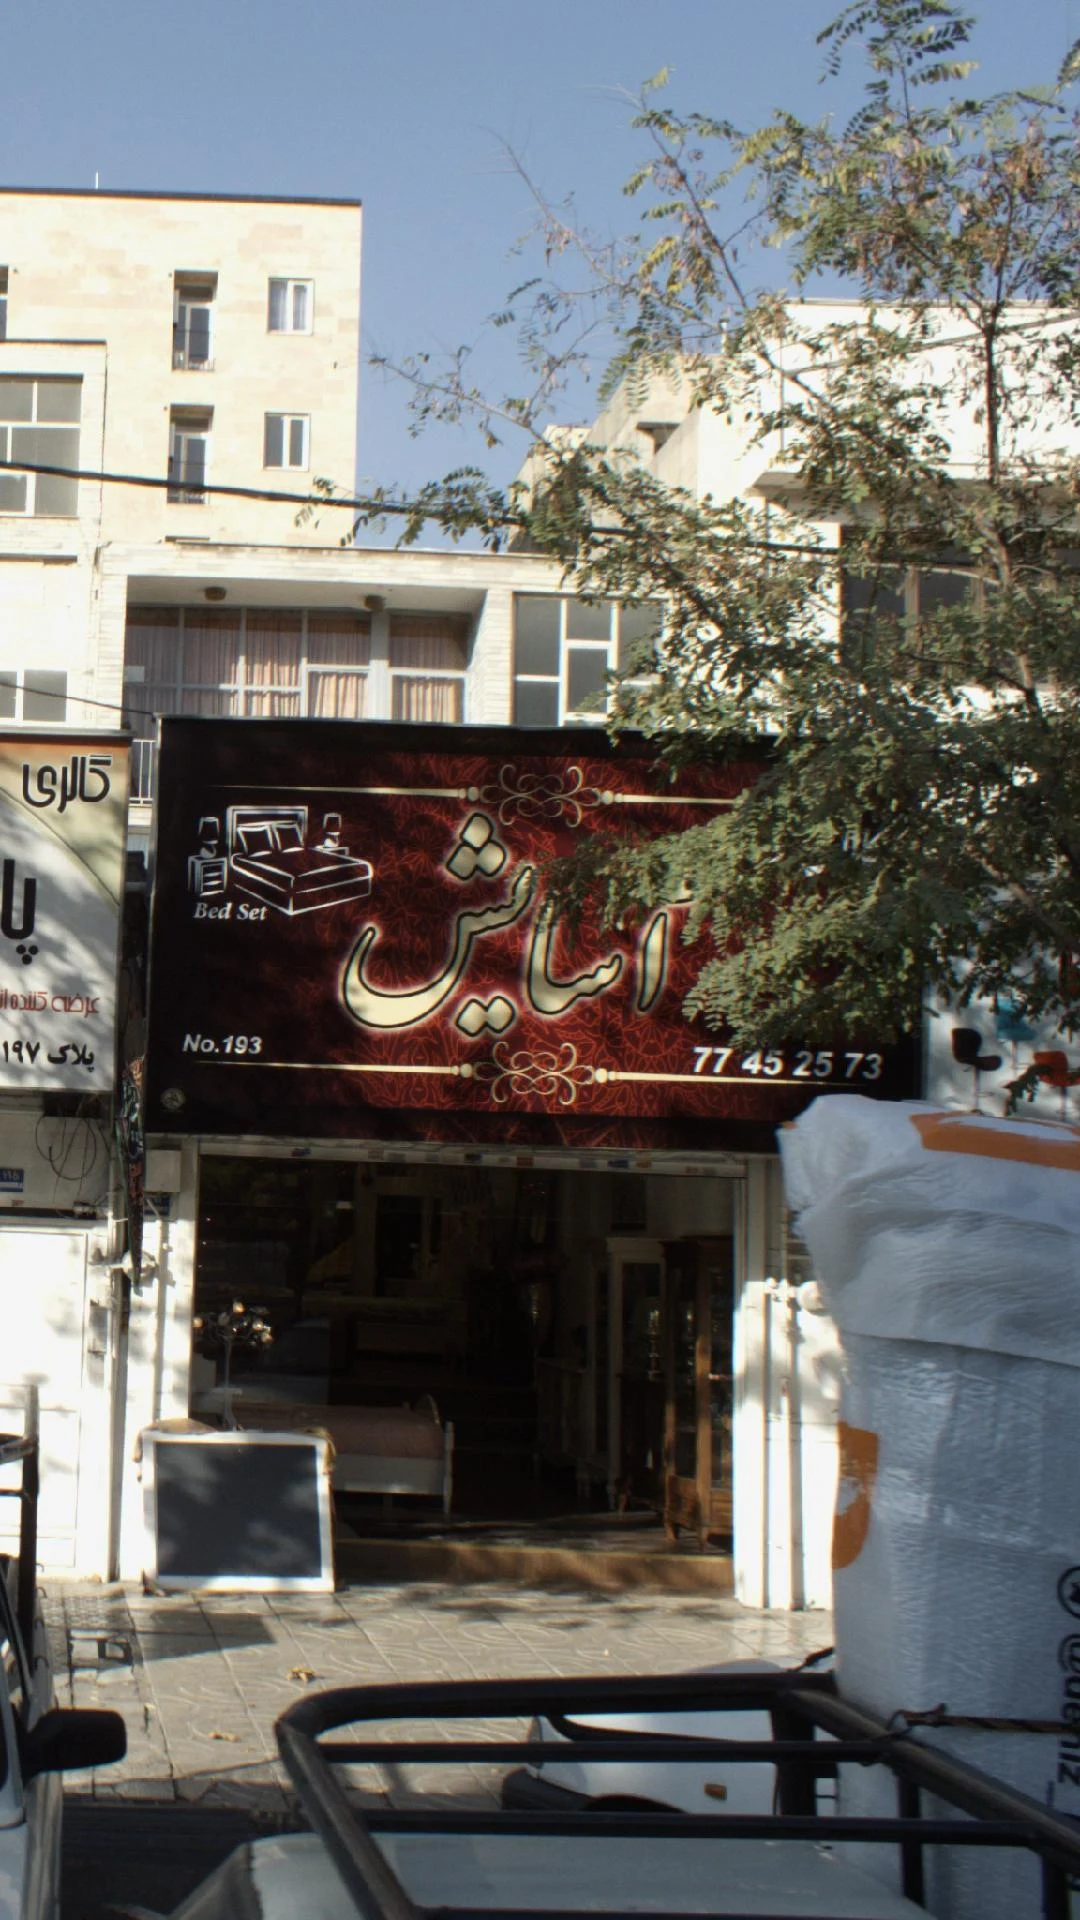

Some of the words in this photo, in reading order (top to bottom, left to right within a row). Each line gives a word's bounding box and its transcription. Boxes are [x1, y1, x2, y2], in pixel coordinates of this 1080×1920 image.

[23, 755, 112, 813] گالری
[193, 902, 232, 920] Bed
[236, 903, 268, 921] Set
[10, 991, 48, 1012] کننده
[51, 993, 100, 1018] عرضه
[2, 1040, 41, 1064] ۱۹۷
[182, 1032, 264, 1055] No.193
[47, 1043, 95, 1073] پلاک
[693, 1046, 733, 1073] 77
[741, 1050, 785, 1076] 45
[792, 1051, 833, 1078] 25
[844, 1052, 882, 1080] 73
